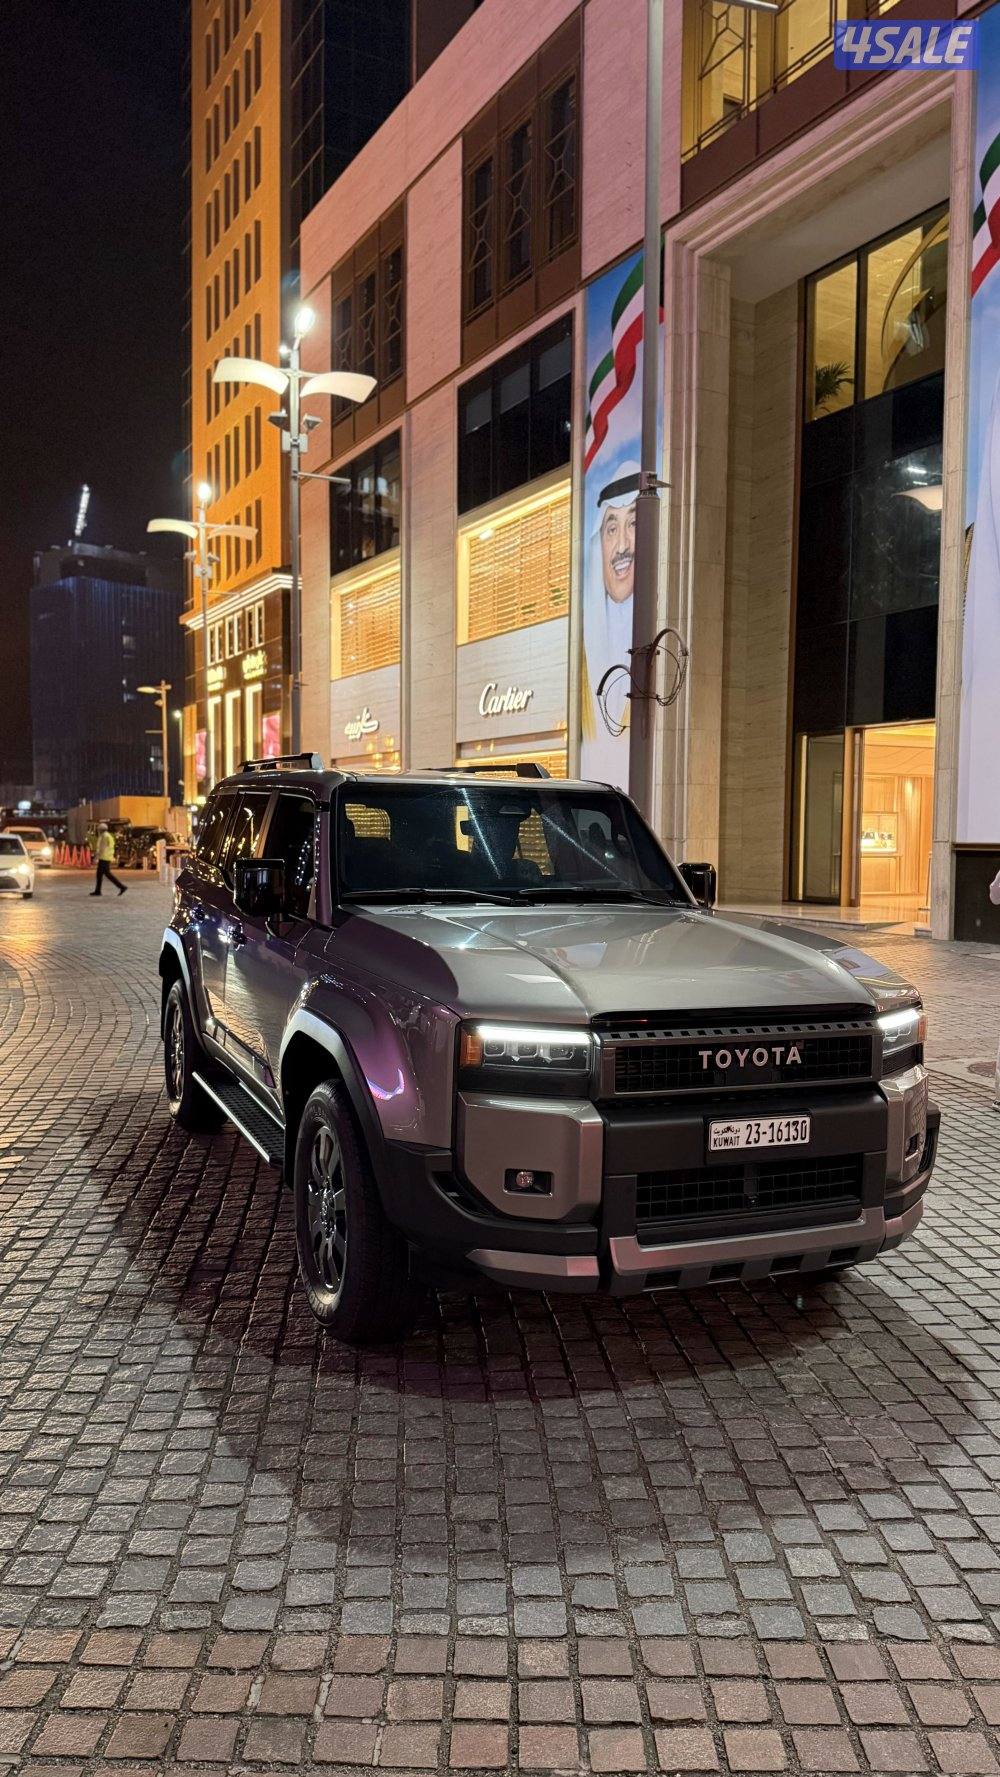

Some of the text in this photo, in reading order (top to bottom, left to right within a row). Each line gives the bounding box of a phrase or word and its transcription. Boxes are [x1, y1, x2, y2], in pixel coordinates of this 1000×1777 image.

[479, 682, 533, 716] Cartier
[698, 1046, 802, 1070] TOYOTA
[713, 1135, 741, 1148] KUWAIT
[745, 1120, 808, 1145] 23-16130
